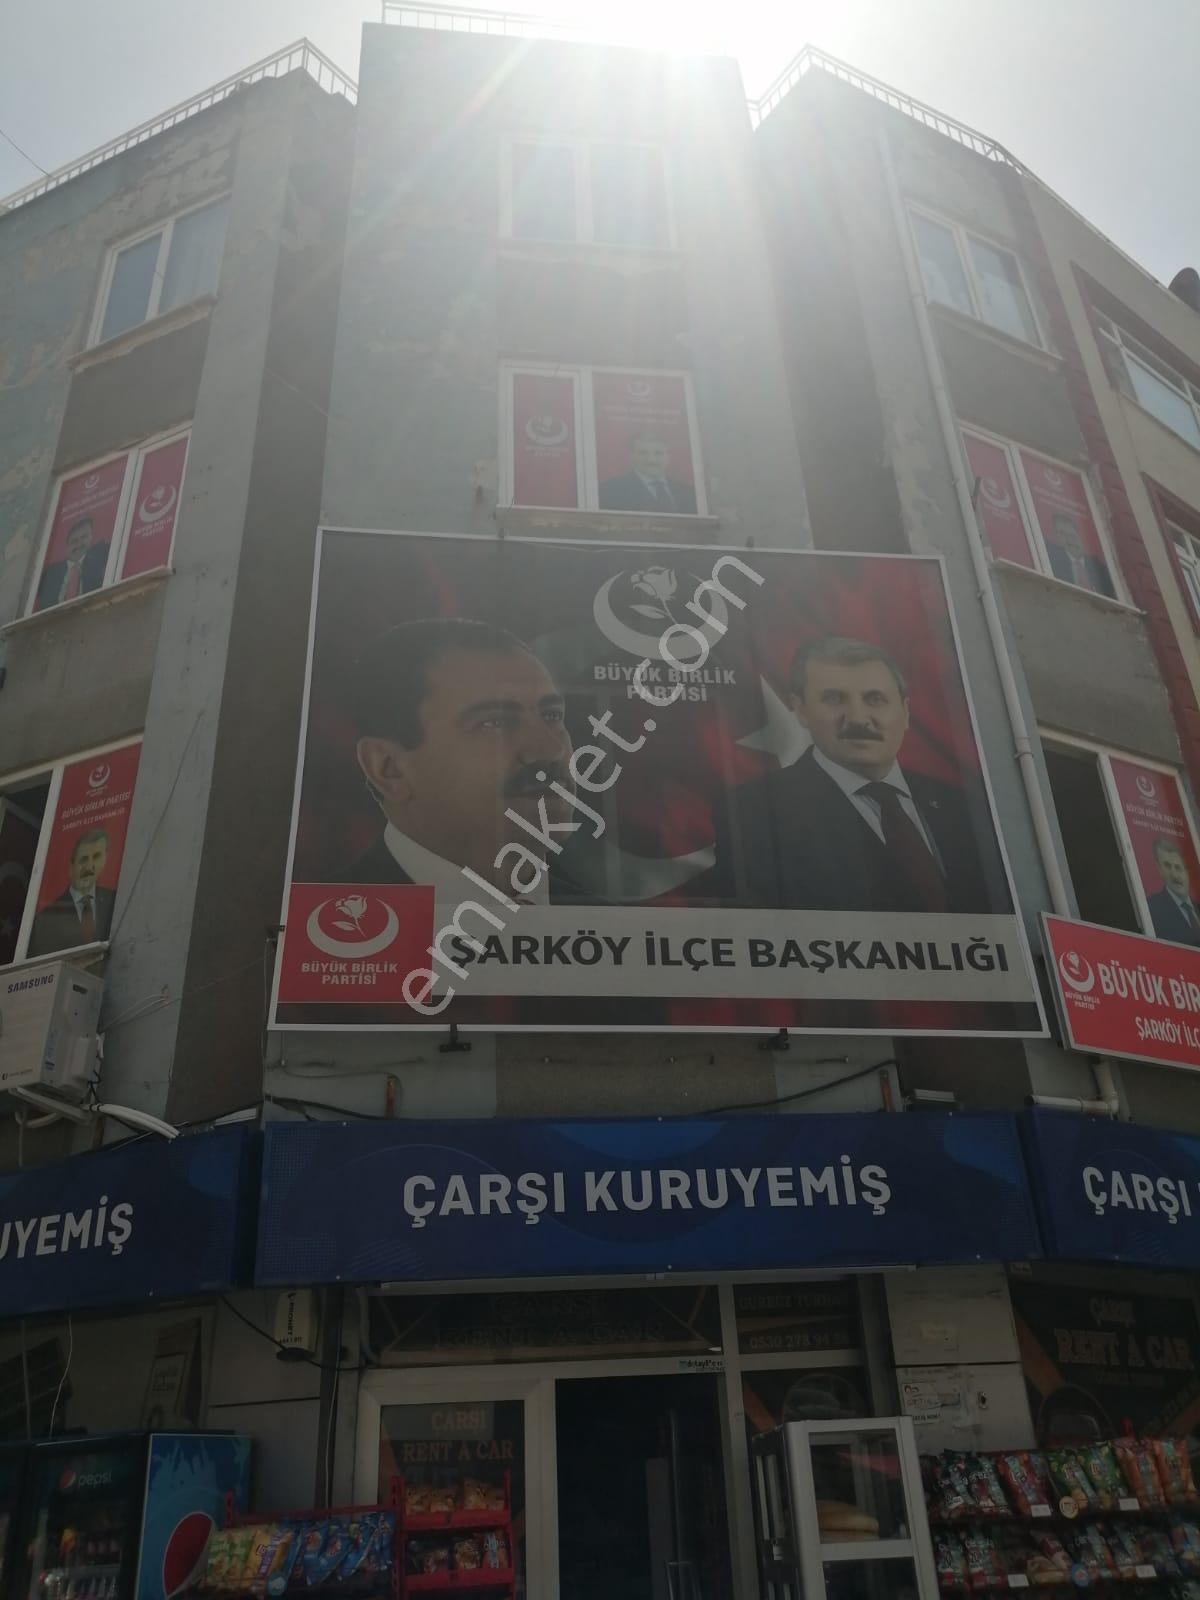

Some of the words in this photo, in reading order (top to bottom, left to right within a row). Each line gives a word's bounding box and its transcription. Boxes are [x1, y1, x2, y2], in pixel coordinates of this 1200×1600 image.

[594, 663, 661, 682] BÜYÜK
[668, 667, 736, 685] BİRLİK
[450, 929, 632, 968] ŞARKÖY
[645, 930, 736, 971] İLÇE
[750, 936, 1009, 974] BAŞKANLIĞI
[301, 960, 347, 973] BÜYÜK
[351, 961, 399, 973] BİRLİK
[322, 973, 377, 985] PARTİSİ
[7, 974, 54, 994] SAMSUNG
[1097, 959, 1170, 1007] BÜYÜK
[1135, 1016, 1183, 1046] ŞARKÖY
[403, 1171, 566, 1228] ÇARŞI
[584, 1154, 892, 1216] KURUYEMİŞ
[1082, 1166, 1192, 1224] ÇARŞI
[1127, 1333, 1145, 1367] A
[403, 1441, 455, 1463] RENT
[457, 1441, 471, 1461] A
[476, 1439, 514, 1460] CAR
[79, 1471, 112, 1488] pepsi
